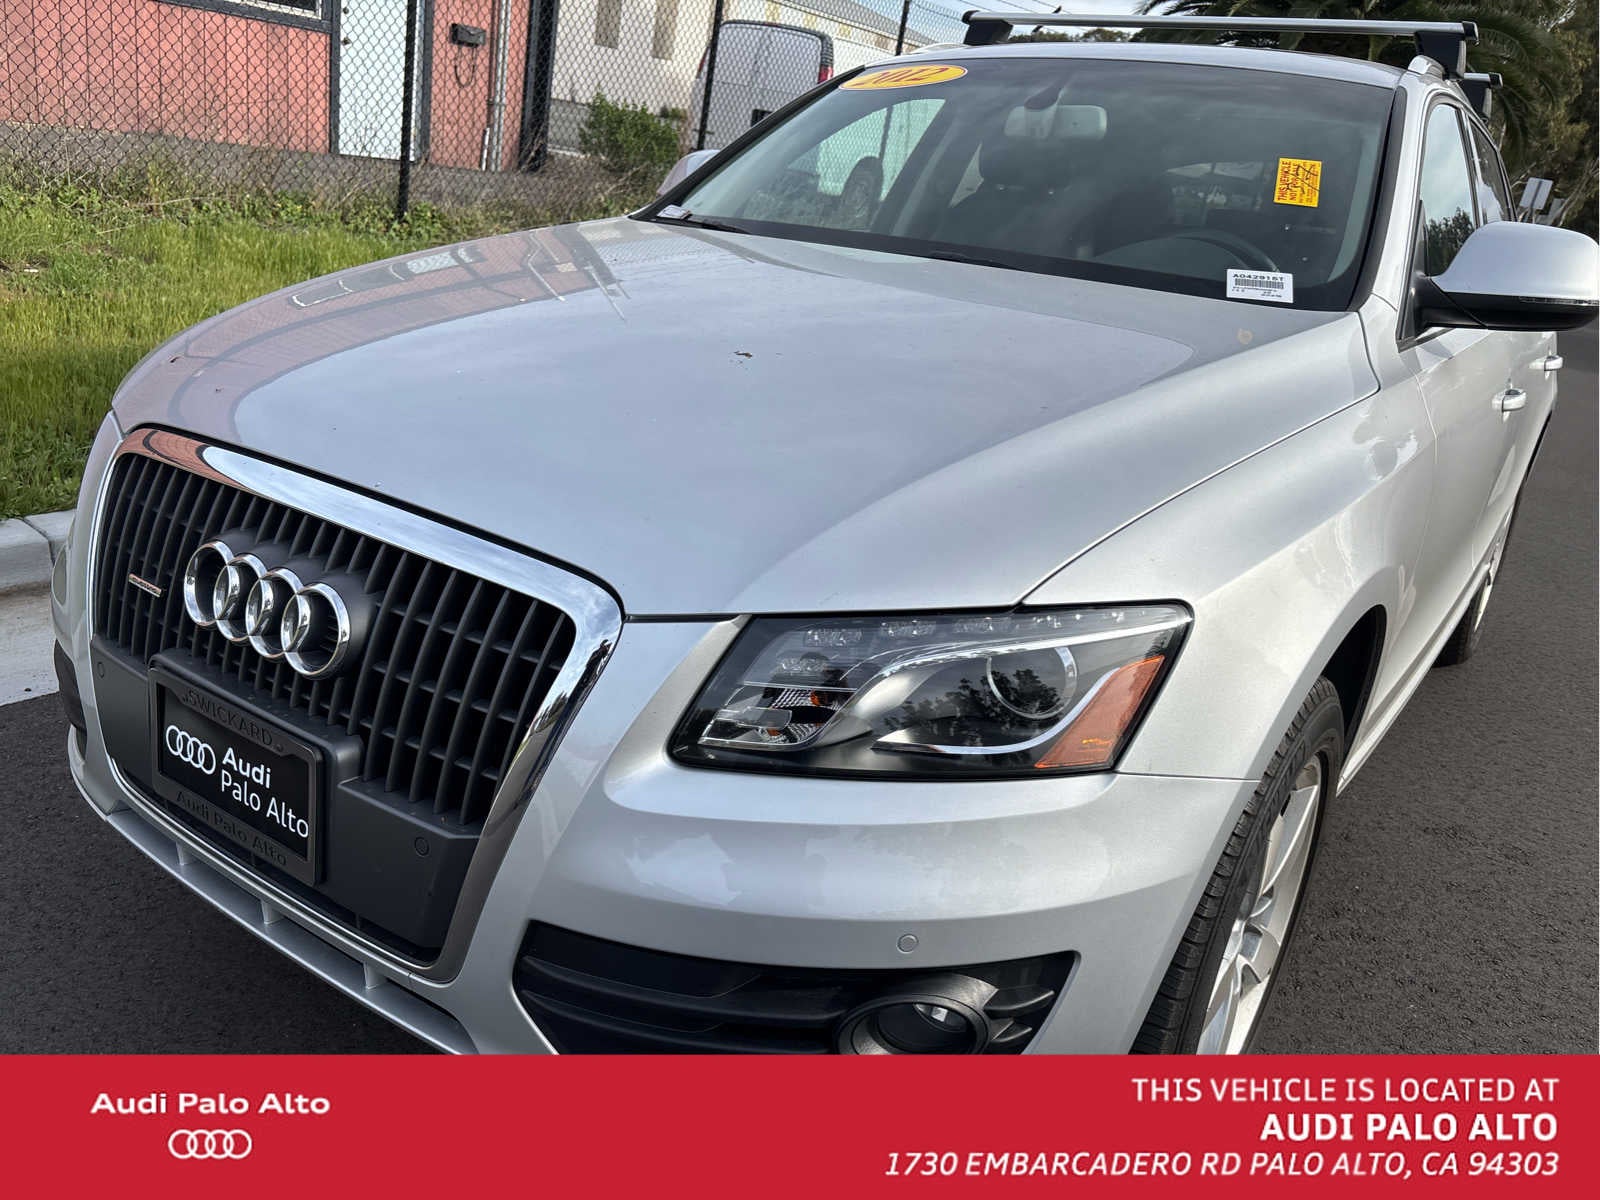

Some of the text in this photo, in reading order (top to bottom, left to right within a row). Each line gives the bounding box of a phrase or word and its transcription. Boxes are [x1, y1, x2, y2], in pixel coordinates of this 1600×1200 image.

[850, 67, 950, 87] 2012
[187, 689, 273, 746] SWICKARD
[222, 747, 272, 789] Audi
[176, 790, 288, 867] Audi Palo Alto
[221, 768, 309, 838] Palo Alto
